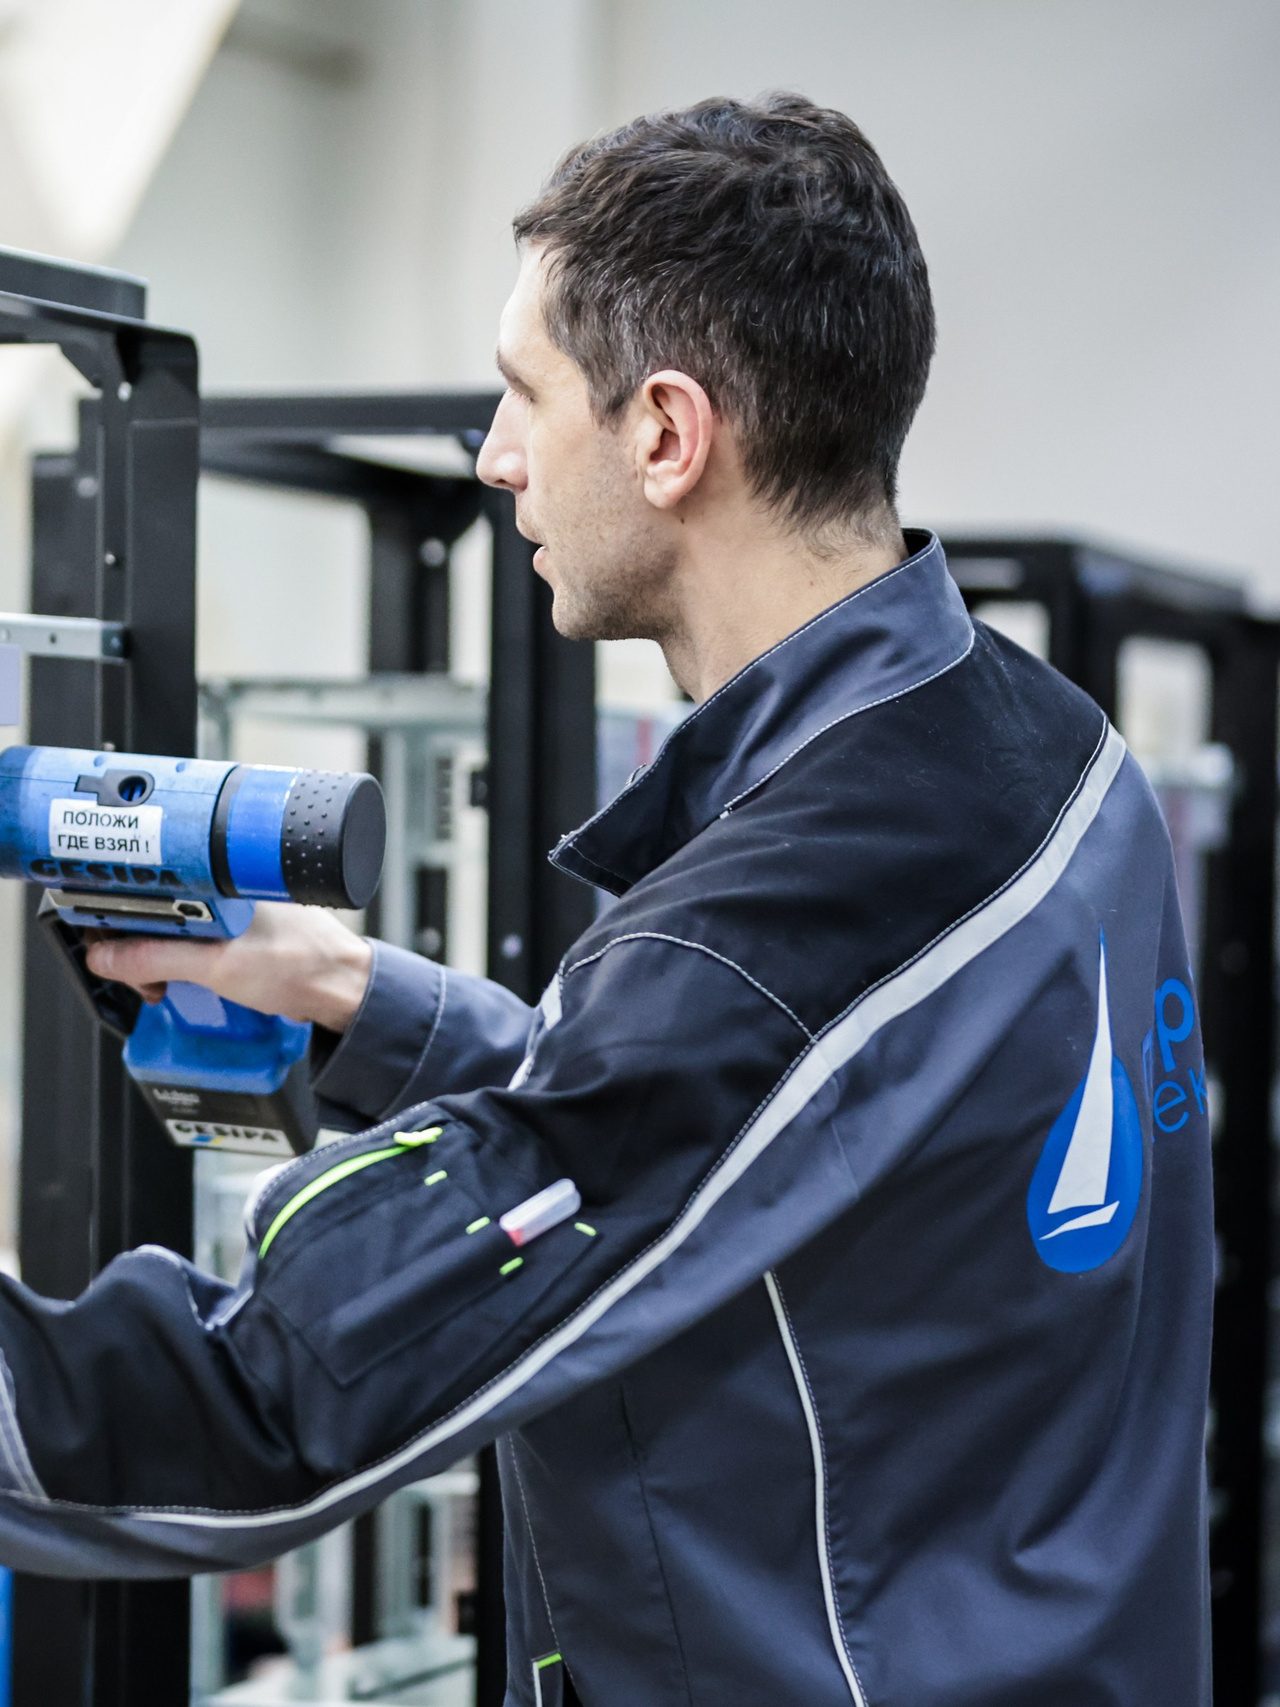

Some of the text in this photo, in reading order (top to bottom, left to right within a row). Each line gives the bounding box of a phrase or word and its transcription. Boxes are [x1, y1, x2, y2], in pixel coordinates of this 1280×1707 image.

[62, 810, 139, 829] ПОЛОЖИ
[58, 834, 90, 850] ГДЕ
[94, 836, 140, 853] ВЗЯЛ
[30, 858, 184, 887] GESIPA
[173, 1122, 280, 1143] GESIPA
